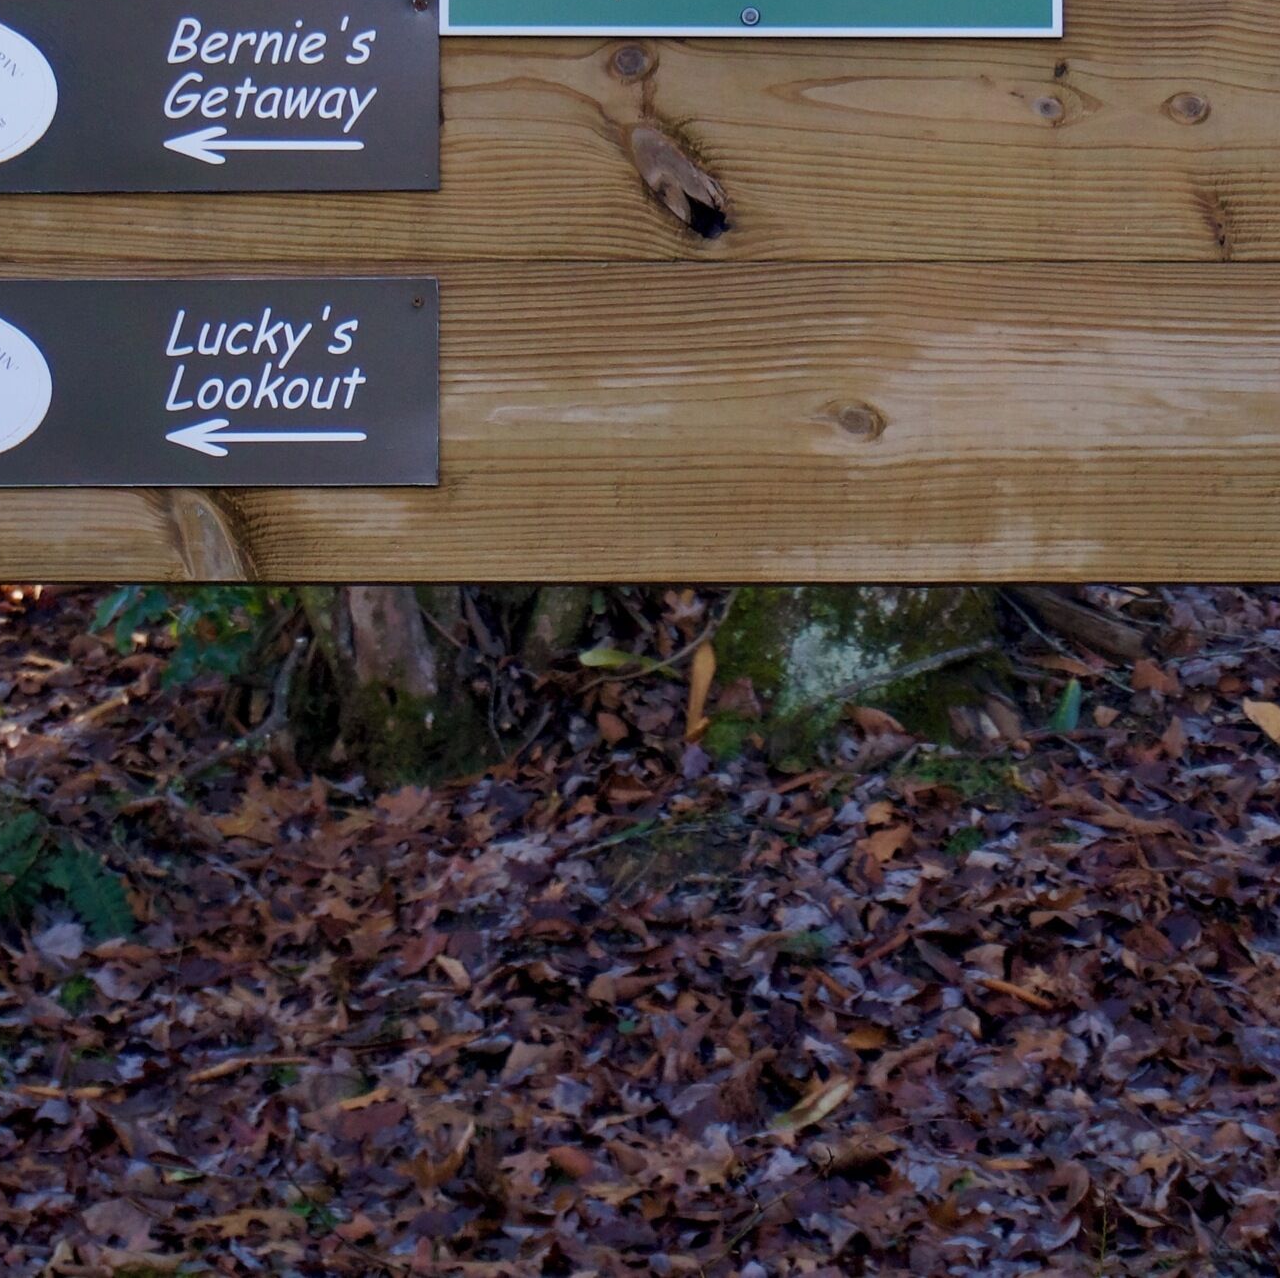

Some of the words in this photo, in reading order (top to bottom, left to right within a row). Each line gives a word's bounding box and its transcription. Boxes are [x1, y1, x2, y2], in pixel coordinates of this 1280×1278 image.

[167, 16, 377, 64] Bernie's
[163, 72, 378, 133] Getaway
[166, 305, 359, 369] Lucky's
[166, 362, 367, 411] Lookout
